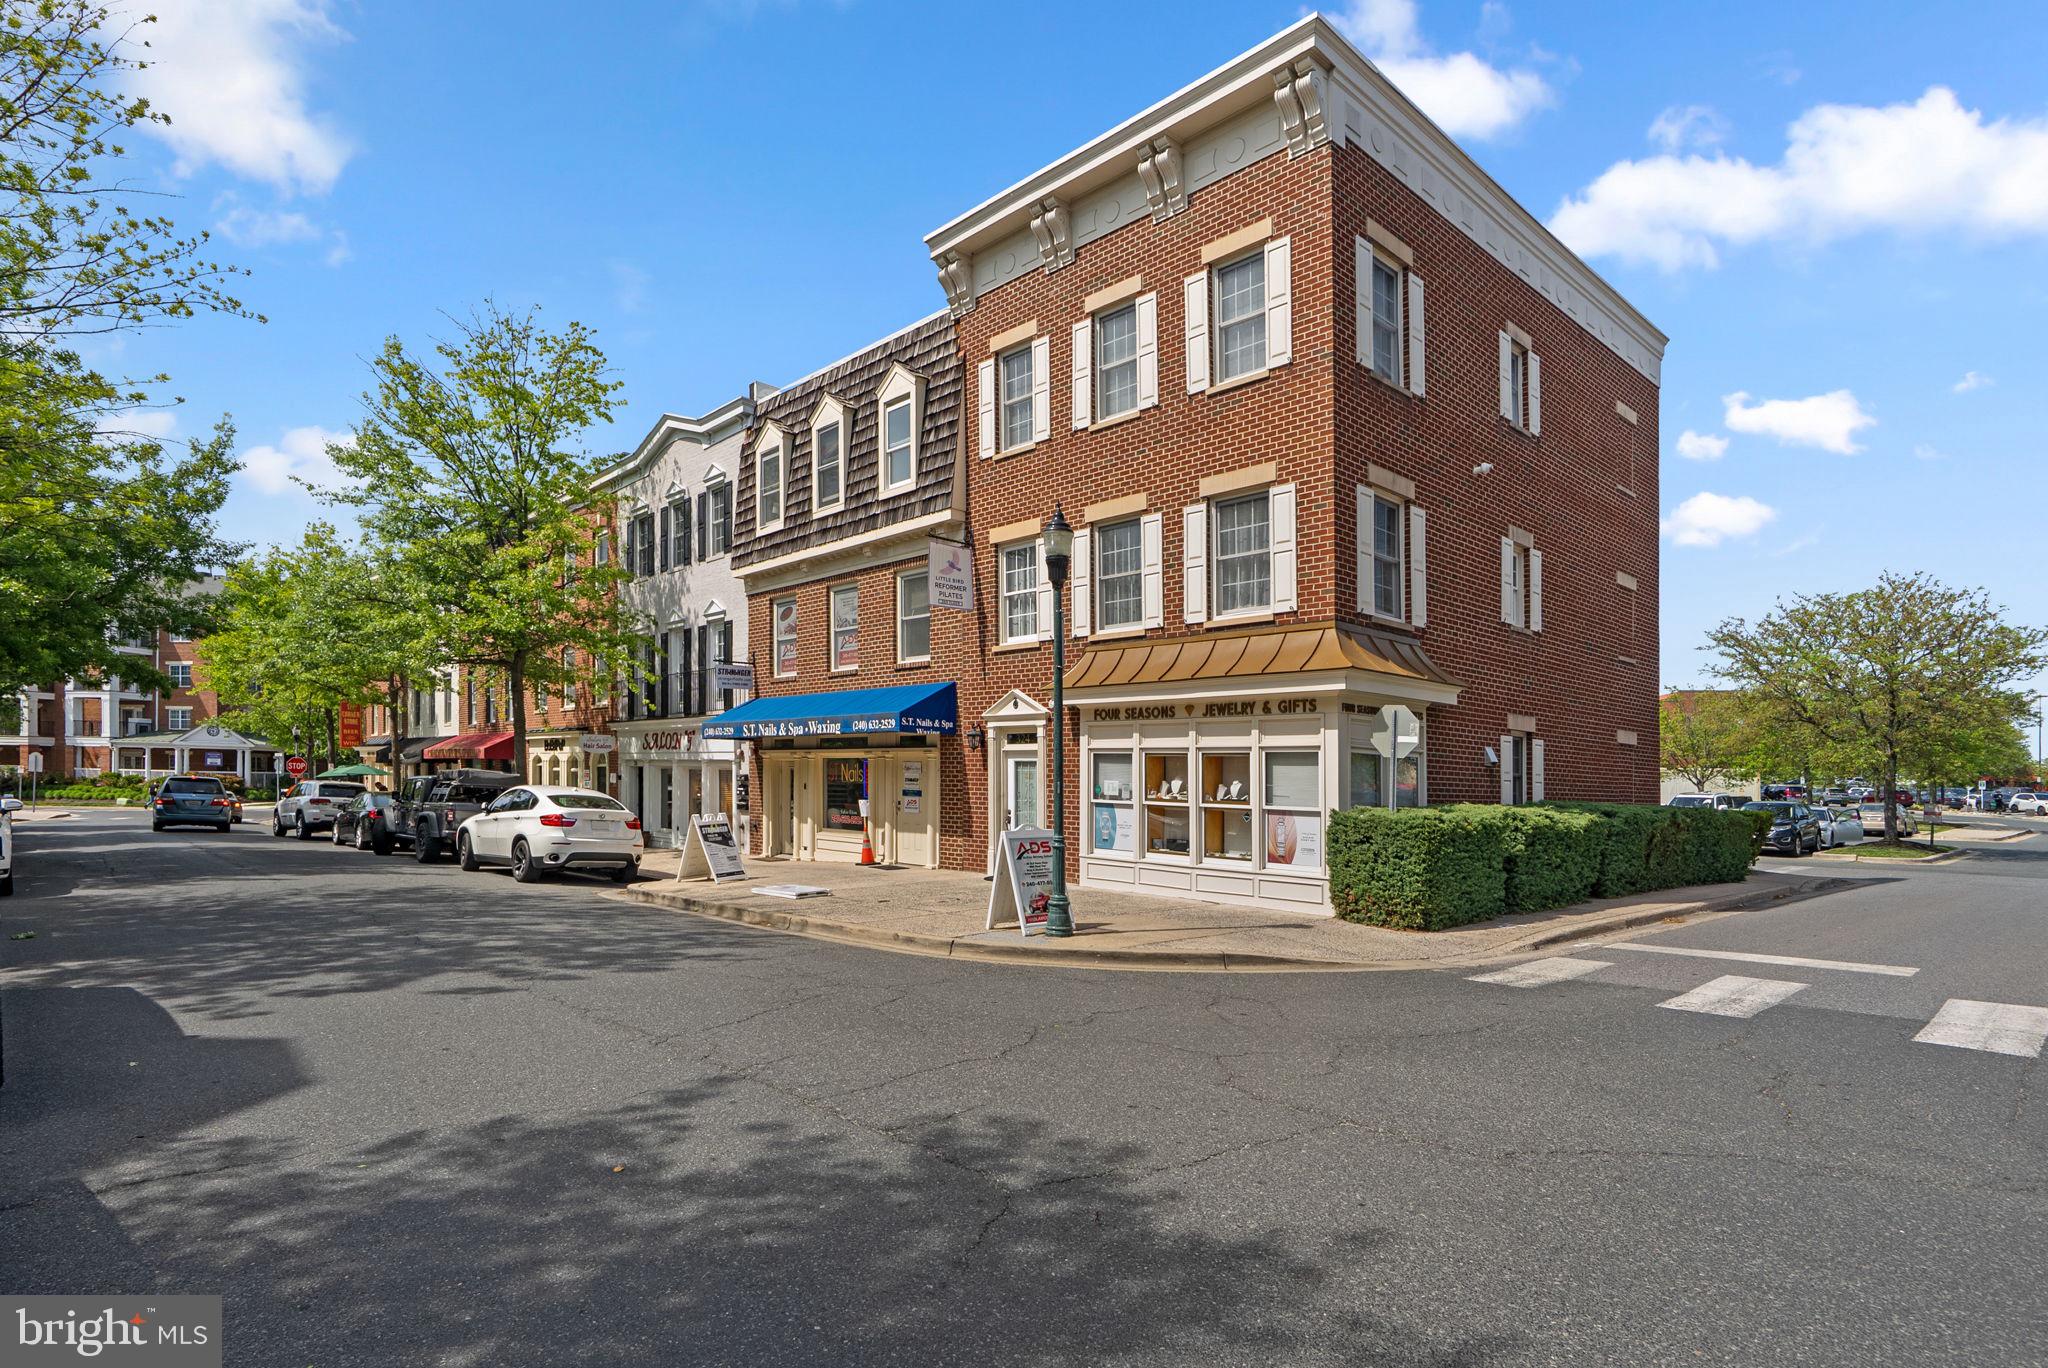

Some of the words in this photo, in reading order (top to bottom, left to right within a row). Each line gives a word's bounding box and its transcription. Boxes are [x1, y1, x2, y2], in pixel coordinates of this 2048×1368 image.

[935, 582, 967, 592] REFORMER
[939, 591, 963, 599] PILATES
[1093, 708, 1120, 720] FOUR
[1125, 706, 1176, 720] SEASONS
[1202, 701, 1256, 717] JEWELRY
[1262, 701, 1272, 714] &
[1278, 699, 1317, 713] GIFTS
[742, 724, 757, 737] S.T.
[758, 723, 777, 736] Nails
[779, 722, 786, 735] &
[788, 722, 804, 737] Spa
[808, 720, 841, 735] Waxing
[852, 720, 868, 731] (240)
[868, 719, 896, 729] 632-2529
[901, 717, 915, 726] S.T.
[916, 719, 932, 727] Nails
[933, 719, 940, 727] &
[941, 719, 954, 728] Spa
[288, 762, 306, 770] STOP
[841, 763, 864, 783] Nails
[1016, 841, 1052, 859] ADS
